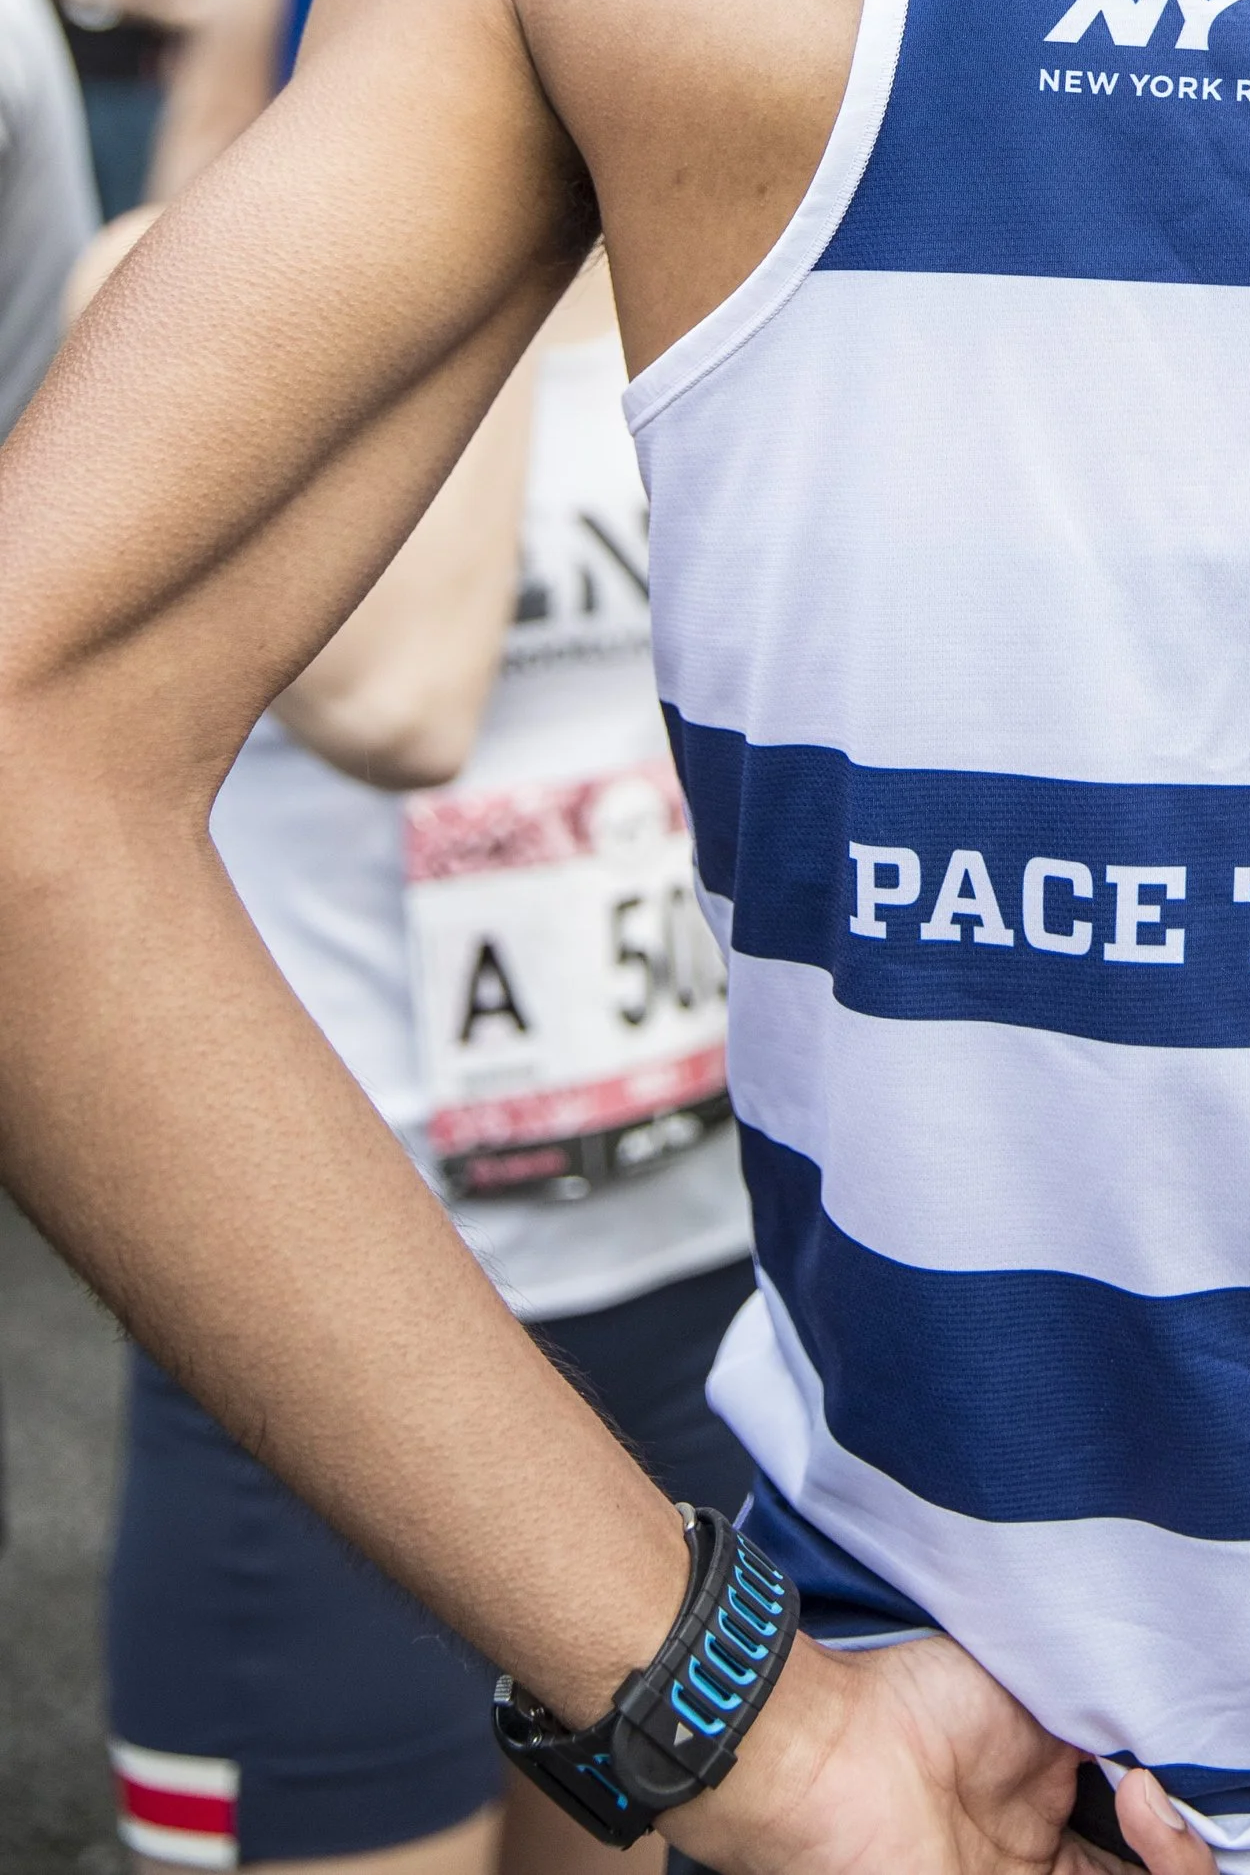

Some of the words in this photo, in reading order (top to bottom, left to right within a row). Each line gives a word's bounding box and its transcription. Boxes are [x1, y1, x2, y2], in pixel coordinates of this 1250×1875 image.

[1039, 69, 1119, 97] NEW
[1129, 73, 1223, 102] YORK
[848, 840, 1188, 965] PACE
[456, 931, 530, 1045] A
